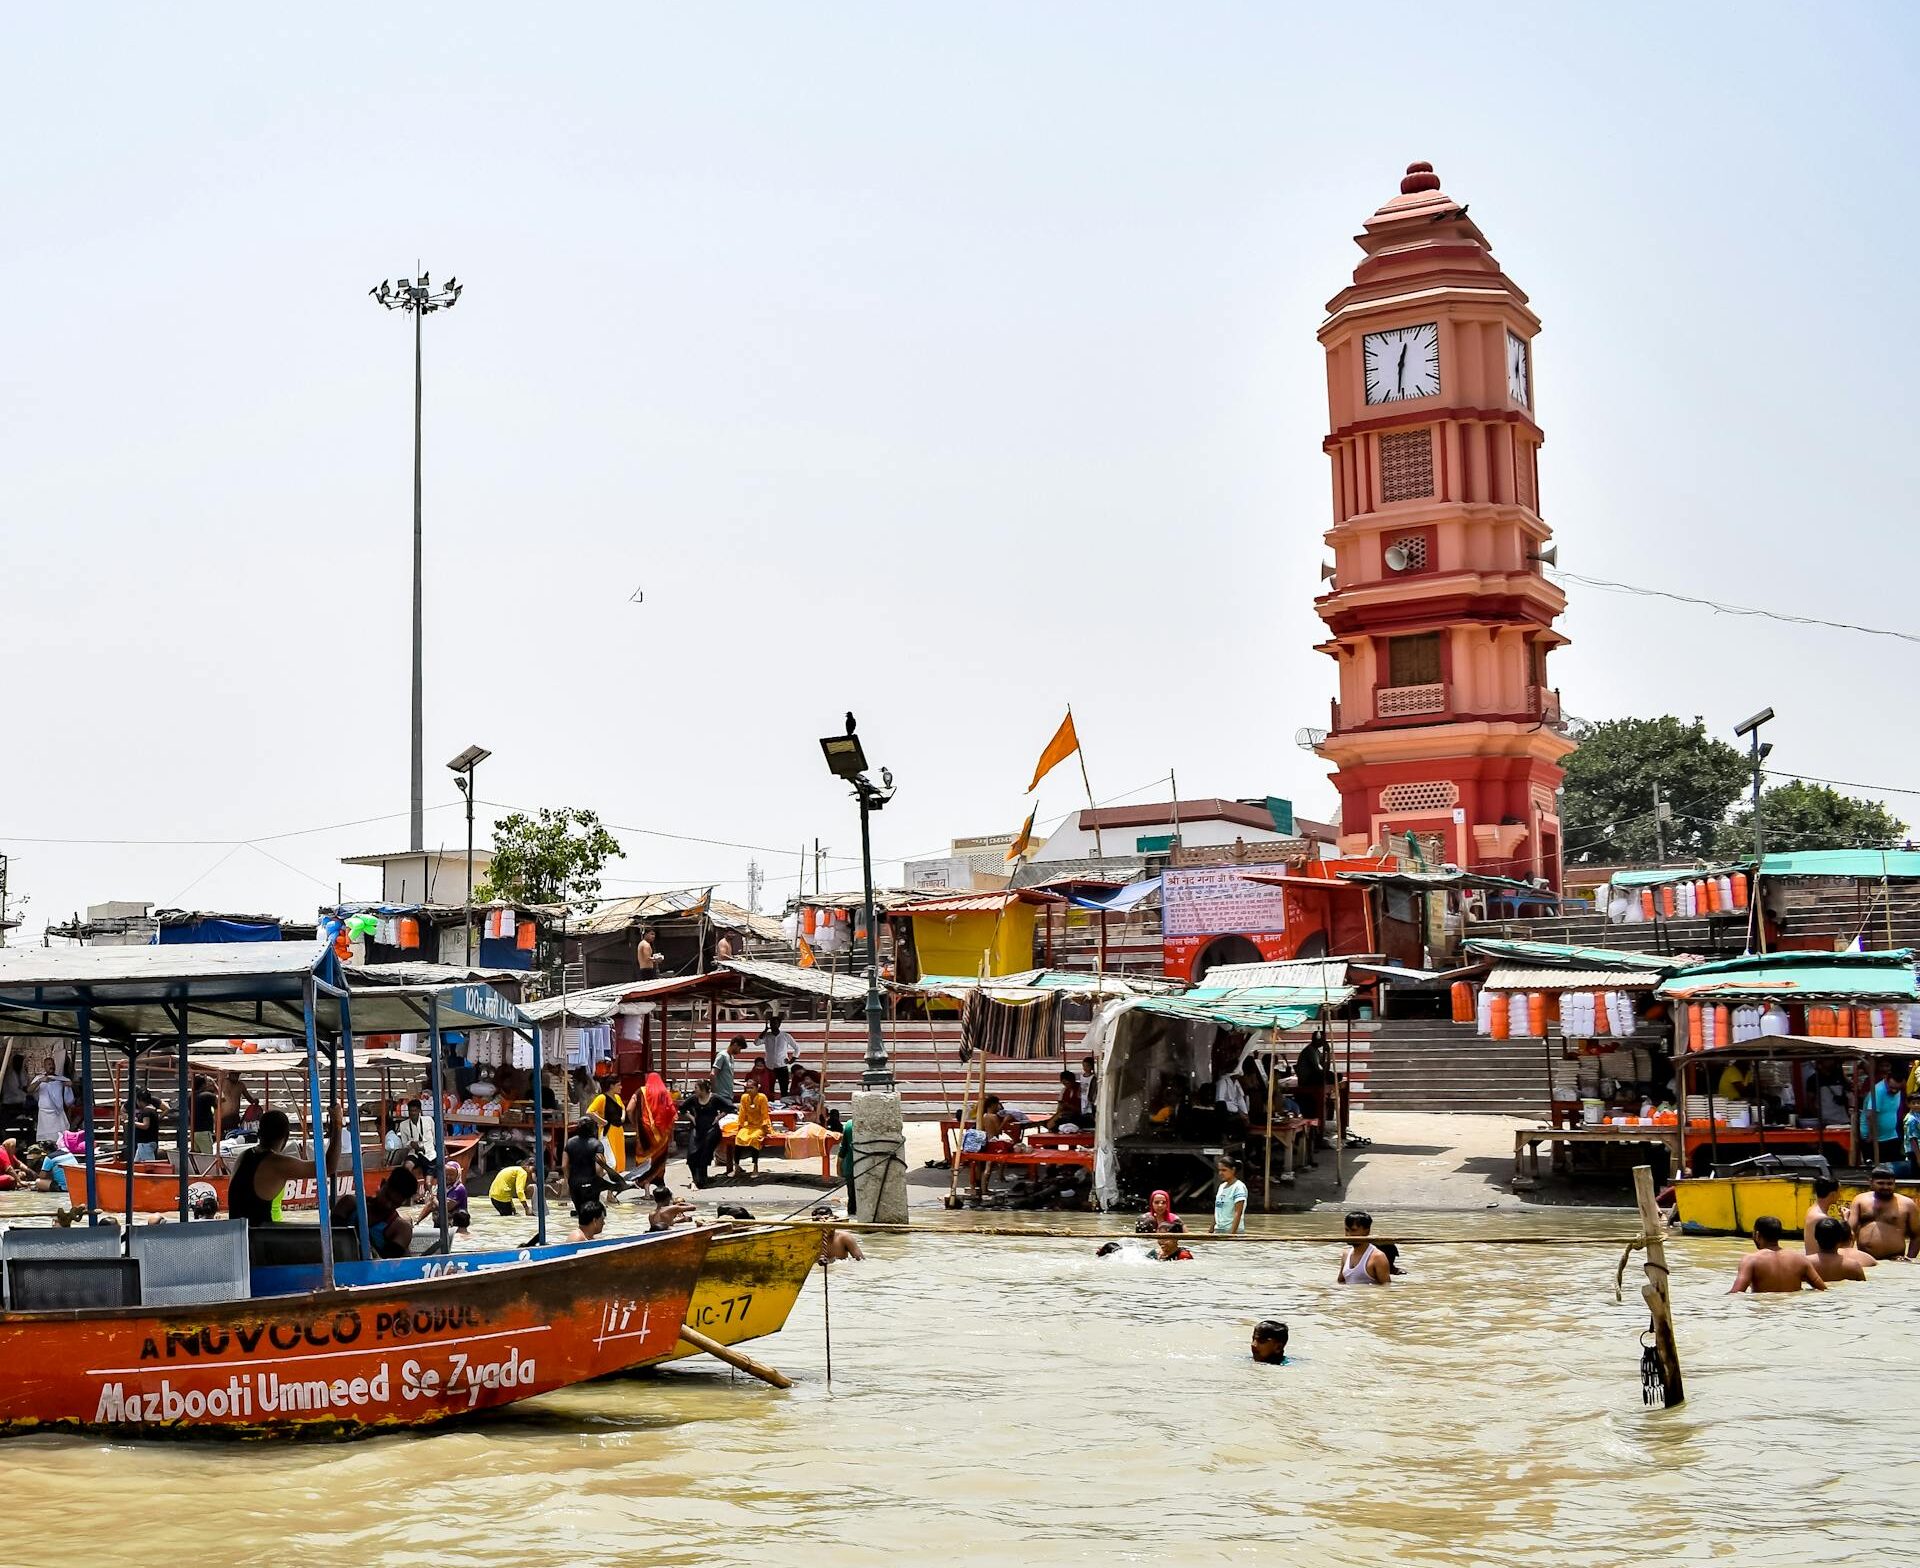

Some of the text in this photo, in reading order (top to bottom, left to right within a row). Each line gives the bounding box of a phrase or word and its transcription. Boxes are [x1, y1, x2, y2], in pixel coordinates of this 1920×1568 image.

[139, 1302, 489, 1361] A NUVOCO PRODUC
[689, 1293, 753, 1329] IC-77
[95, 1347, 536, 1423] Mazbooti Ummeed Se Zyada
